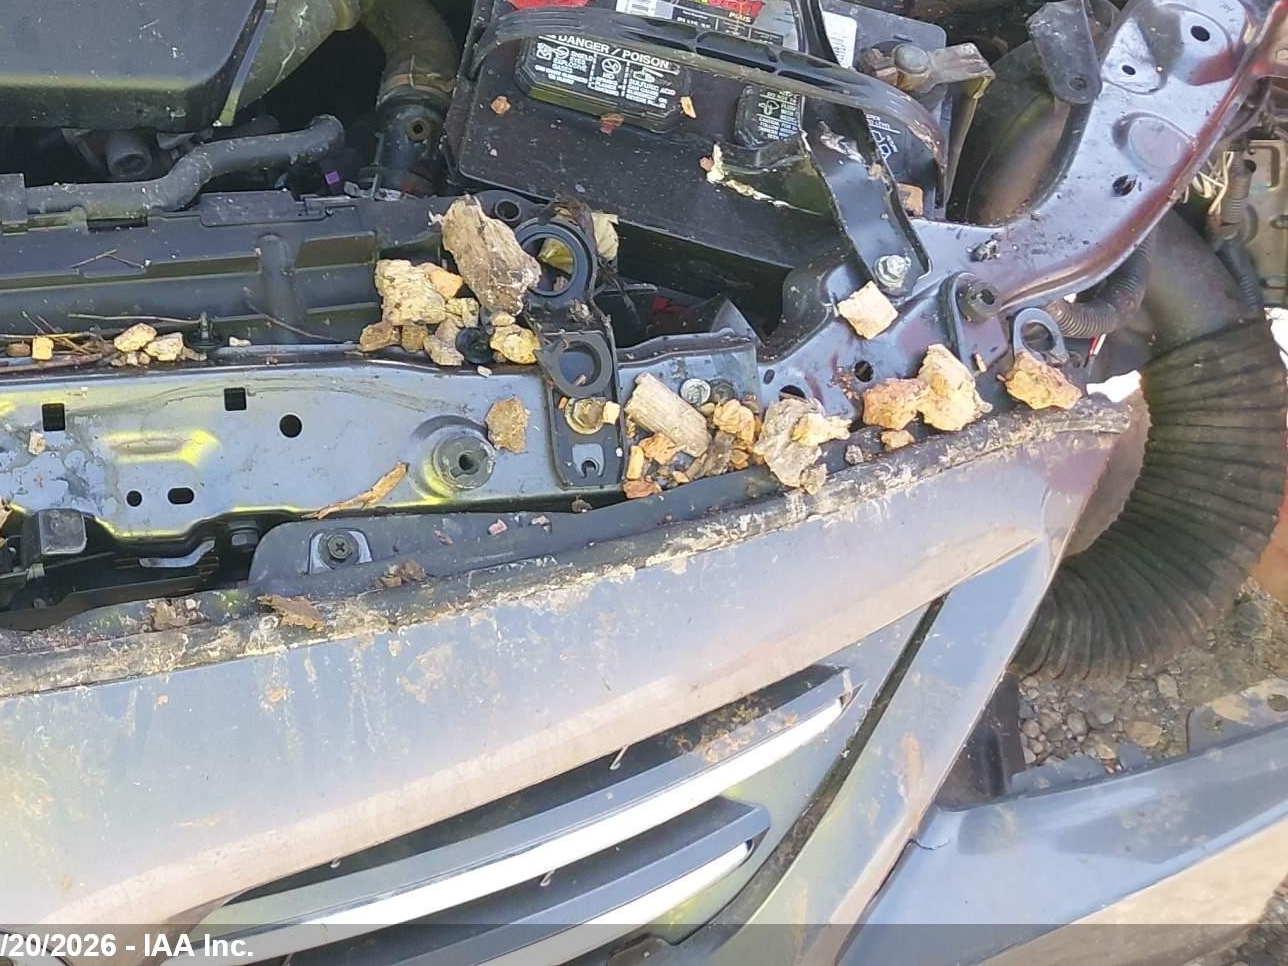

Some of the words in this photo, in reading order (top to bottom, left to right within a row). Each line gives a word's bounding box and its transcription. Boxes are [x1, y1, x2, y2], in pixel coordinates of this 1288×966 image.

[728, 11, 752, 23] PLUS
[558, 34, 611, 54] DANGER
[622, 50, 670, 70] POISON
[602, 72, 615, 80] NO
[660, 87, 676, 96] ACID
